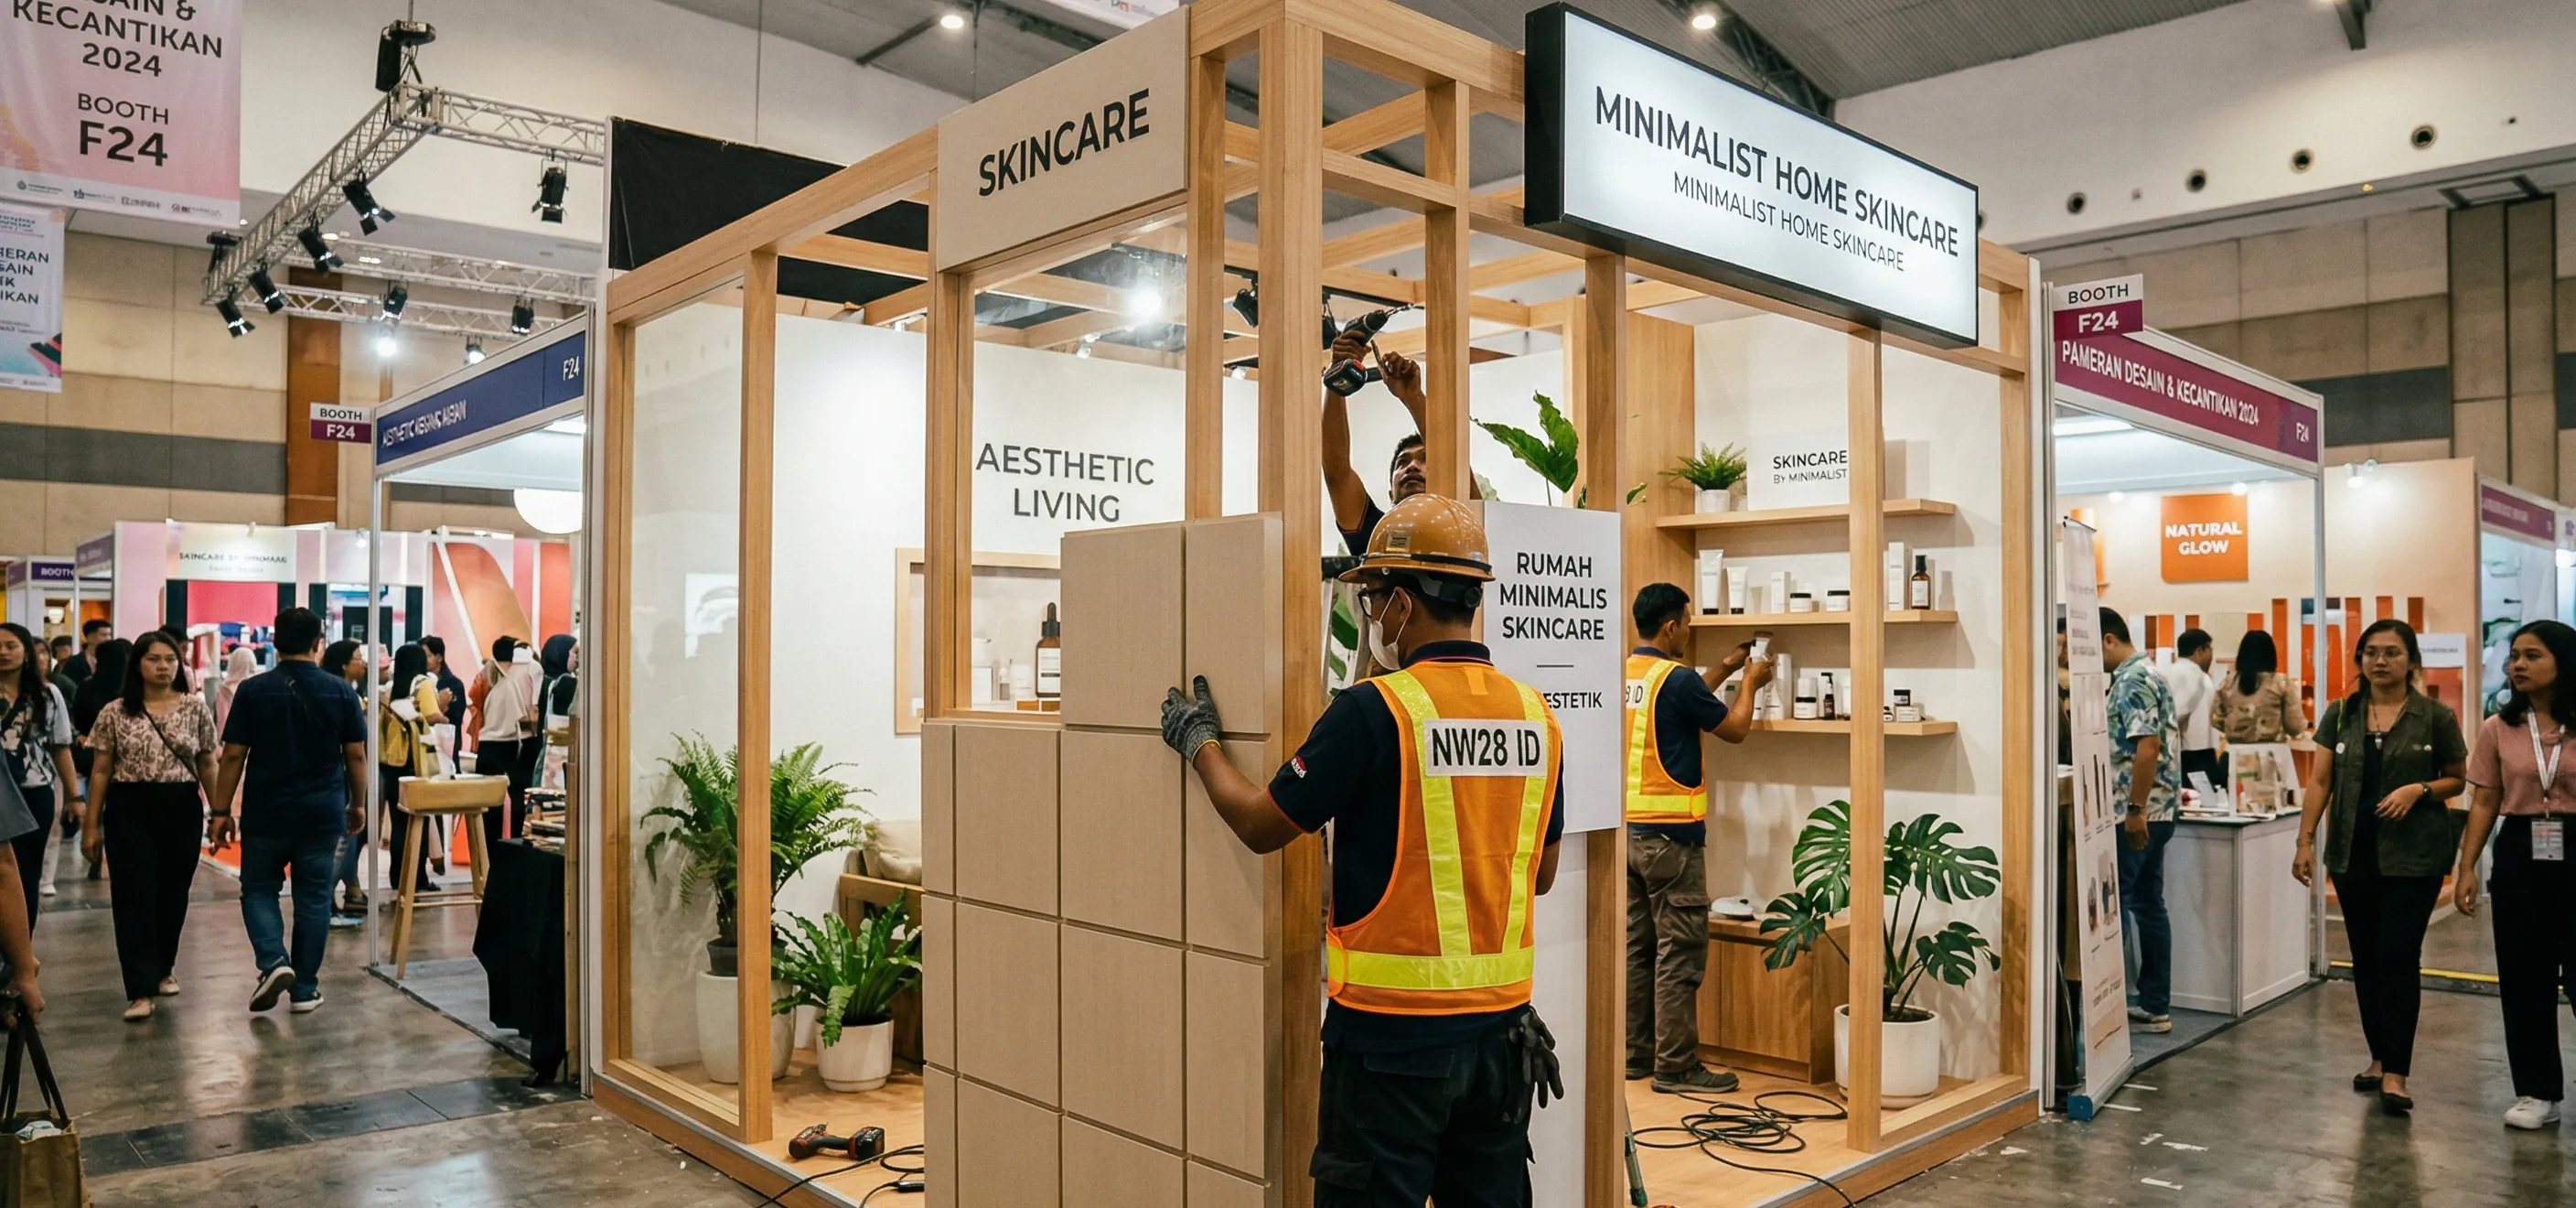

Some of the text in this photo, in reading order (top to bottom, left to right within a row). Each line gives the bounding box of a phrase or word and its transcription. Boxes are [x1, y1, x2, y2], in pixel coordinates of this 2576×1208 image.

[176, 0, 196, 21] &
[13, 0, 222, 59] KECANTIKAN
[82, 43, 162, 77] 2024
[78, 92, 168, 124] BOOTH
[80, 120, 167, 166] F24
[979, 88, 1149, 197] SKINCARE
[1596, 85, 1958, 257] MINIMALIST HOME SKINCARE
[1674, 171, 1904, 271] MINIMALIST HOME SKINCARE
[2068, 284, 2129, 304] BOOTH
[2078, 311, 2119, 333] F24
[563, 355, 580, 381] F24
[2062, 340, 2259, 426] PAMERAN DESAIN & KECANTIKAN 2024
[320, 408, 362, 421] BOOTH
[327, 424, 356, 439] F24
[976, 443, 1154, 486] AESTHETIC
[1773, 450, 1848, 469] SKINCARE
[1774, 469, 1848, 483] BY MINIMALIST
[1014, 488, 1120, 523] LIVING
[2165, 522, 2243, 538] NATURAL
[2178, 540, 2229, 555] GLOW
[1517, 552, 1592, 578] RUMAH
[1499, 583, 1607, 610] MINIMALIS
[1502, 616, 1605, 641] SKINCARE
[1542, 692, 1603, 709] ESTETIK
[1632, 685, 1643, 703] ID
[1432, 728, 1540, 767] NW28 ID
